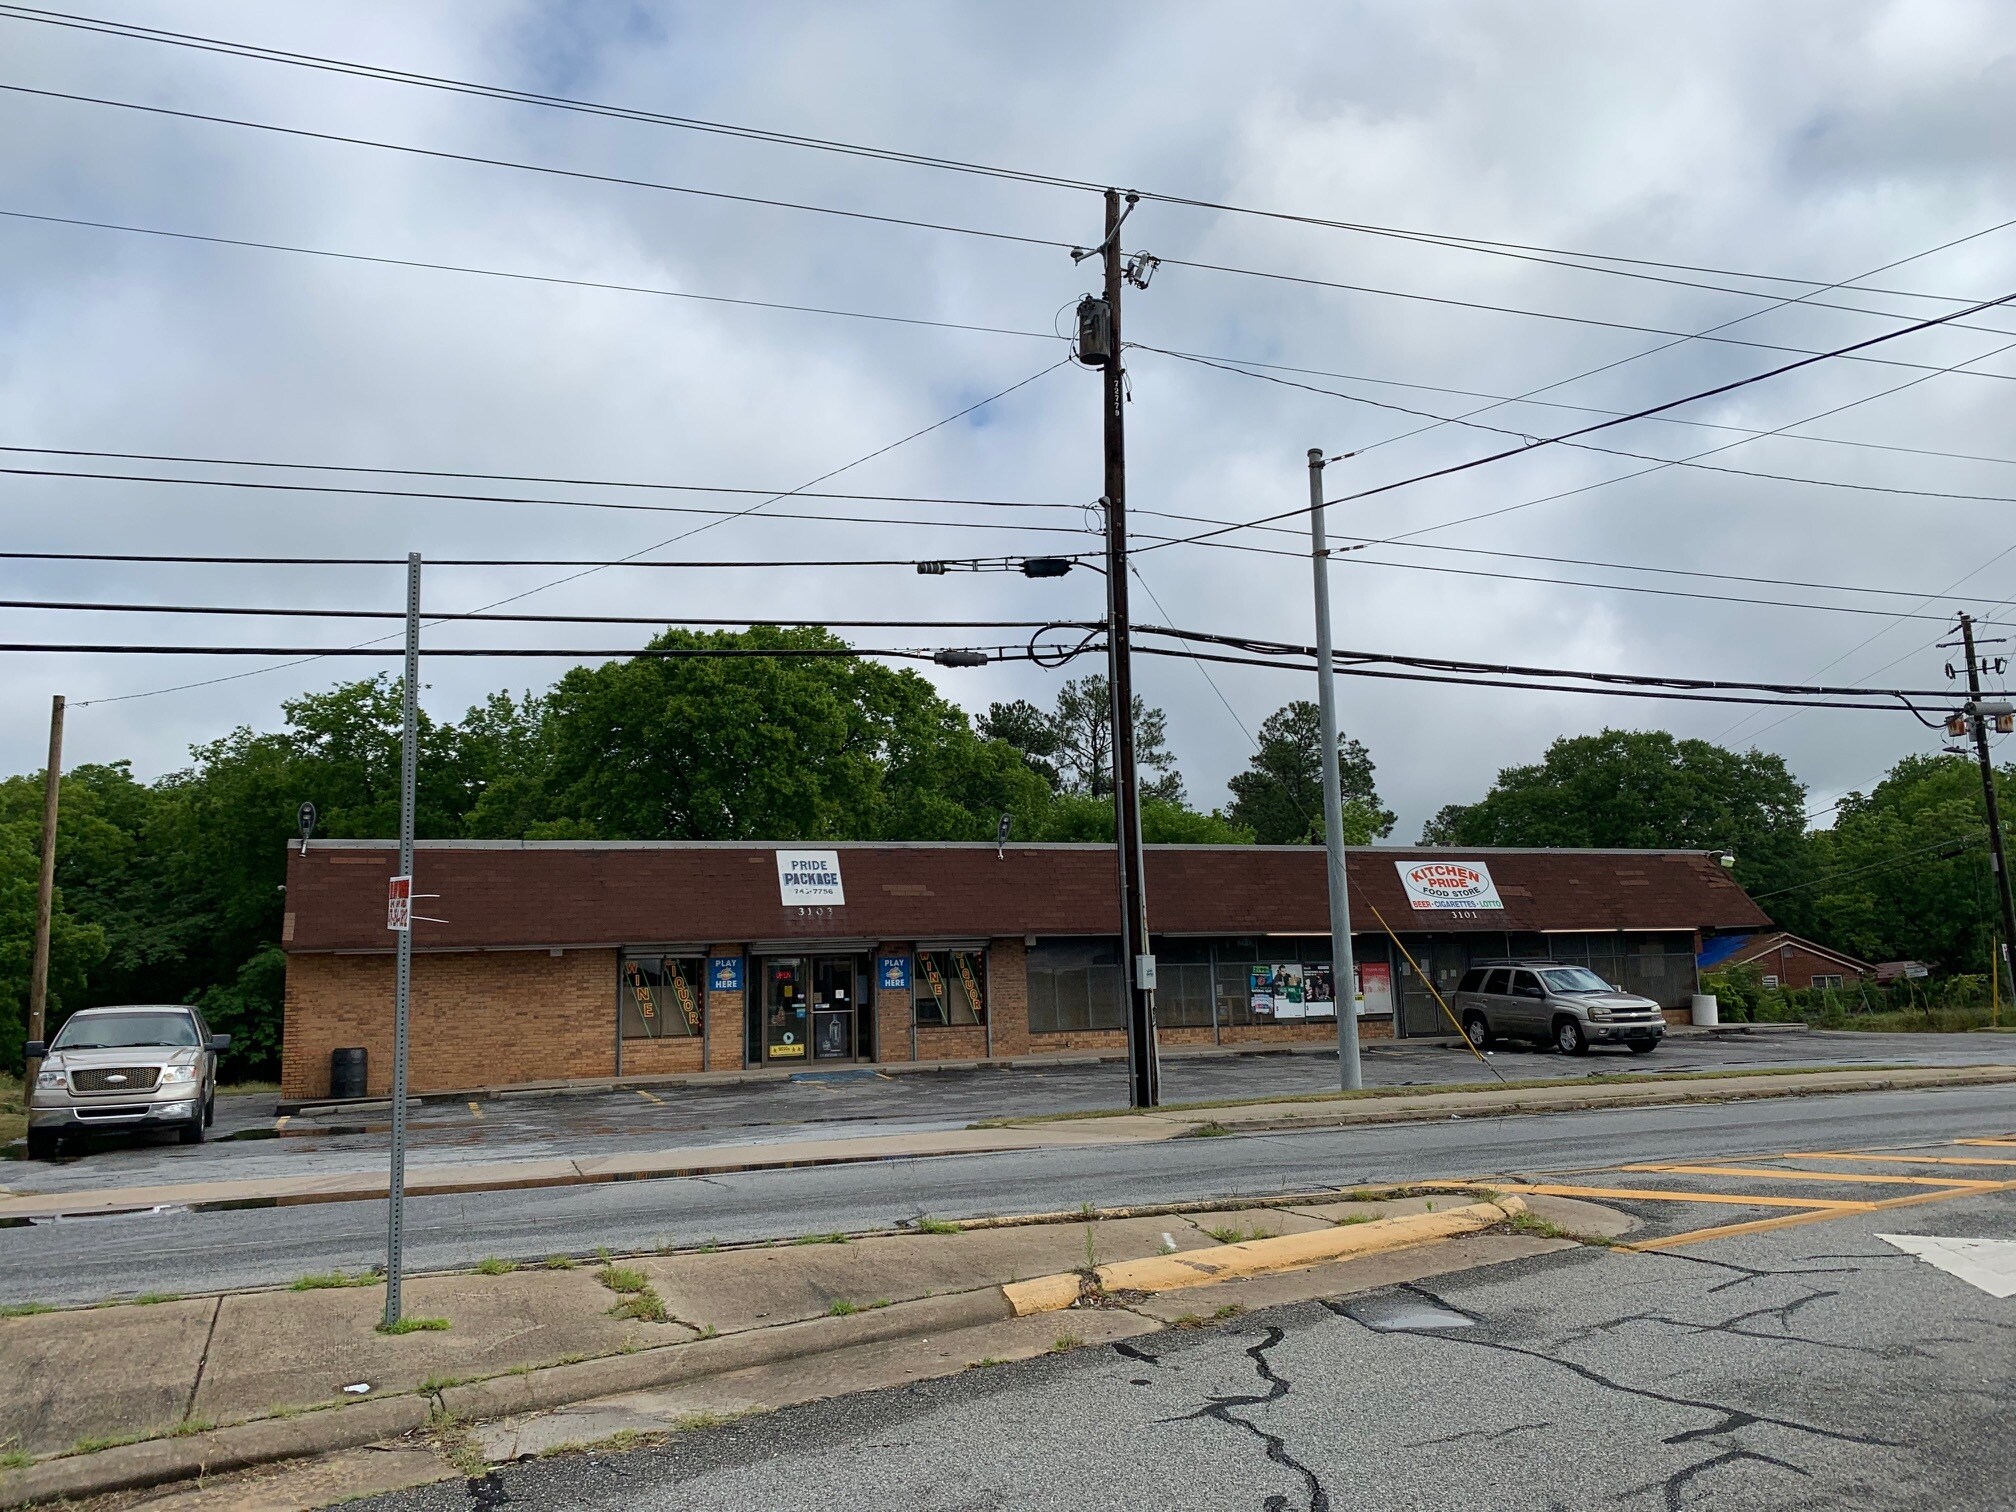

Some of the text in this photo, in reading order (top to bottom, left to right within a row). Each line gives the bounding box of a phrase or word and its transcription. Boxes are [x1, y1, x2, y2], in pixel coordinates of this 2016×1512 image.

[791, 860, 828, 871] PRIDE
[1410, 865, 1480, 883] KITCHEN
[783, 873, 839, 886] PACKAGE
[1428, 878, 1469, 888] PRIDE
[1423, 887, 1481, 897] FOOD STORE
[1412, 900, 1502, 908] BEER CIGARETTES LOTTO
[1451, 911, 1478, 919] 3101
[884, 959, 904, 967] PLAY
[919, 951, 943, 995] WINE
[715, 980, 738, 988] HERE
[885, 979, 905, 987] HERE
[625, 960, 654, 1018] WINE
